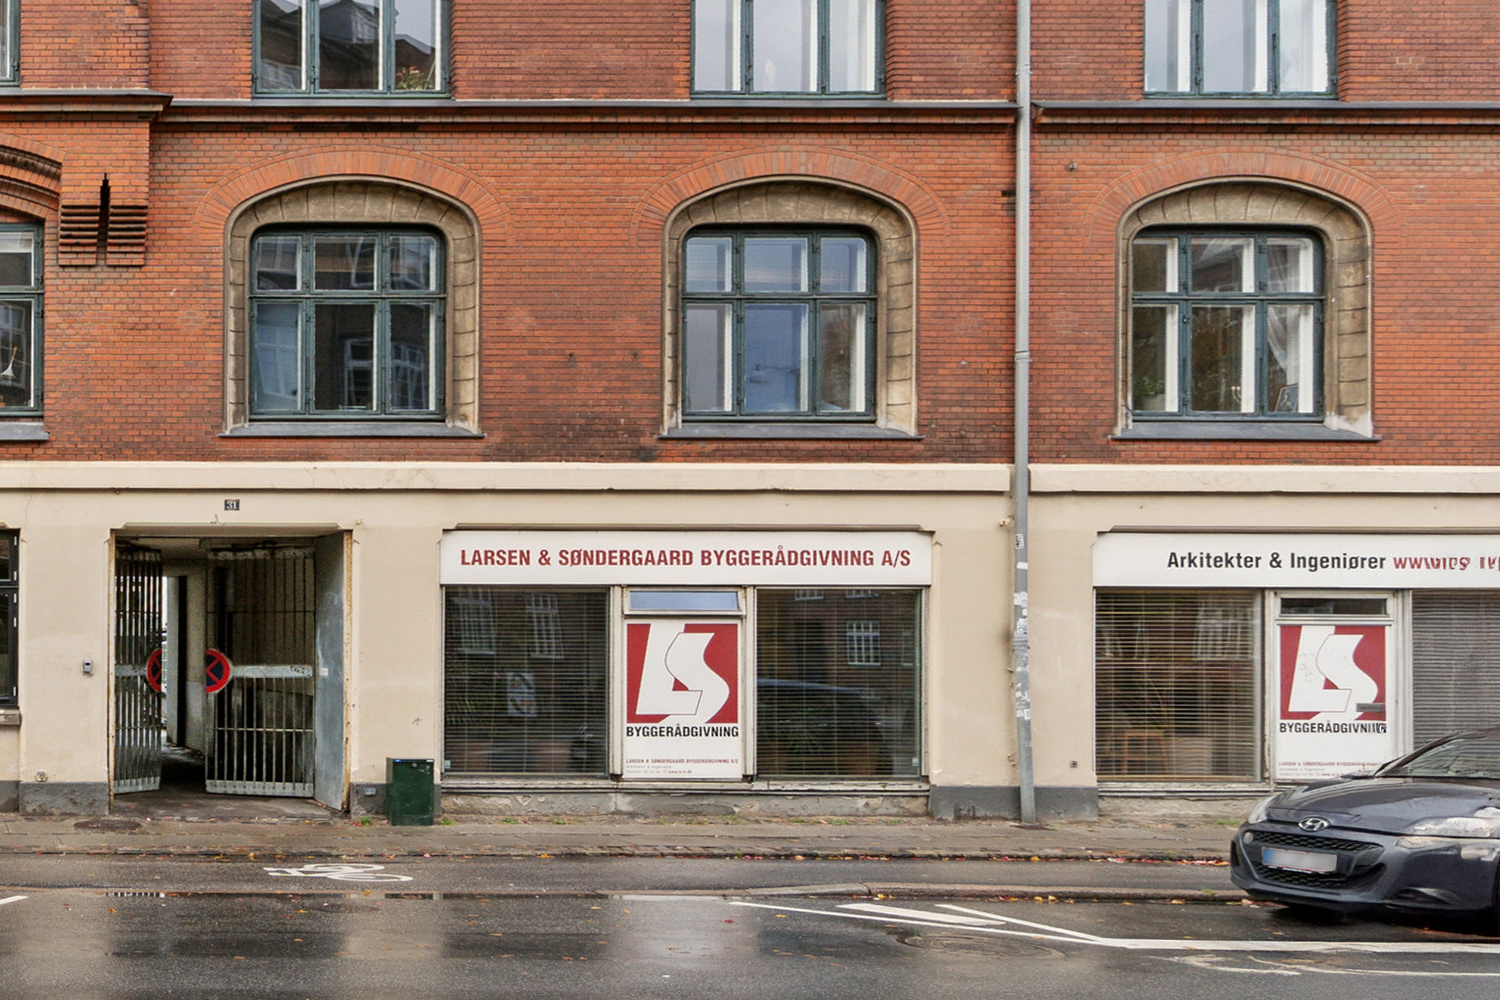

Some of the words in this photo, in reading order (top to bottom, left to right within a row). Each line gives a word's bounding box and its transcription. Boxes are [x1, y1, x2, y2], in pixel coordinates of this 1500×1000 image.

[226, 500, 237, 510] 31
[460, 549, 530, 566] LARSEN
[538, 549, 551, 566] &
[558, 548, 694, 567] SØNDERGAARD
[700, 544, 874, 567] BYGGERÅDGIVNING
[881, 549, 911, 568] A/S
[1167, 552, 1262, 568] Arkitekter
[1269, 552, 1282, 568] &
[1290, 552, 1386, 572] Ingeniører
[626, 723, 739, 737] BYGGERÅDGIVNING
